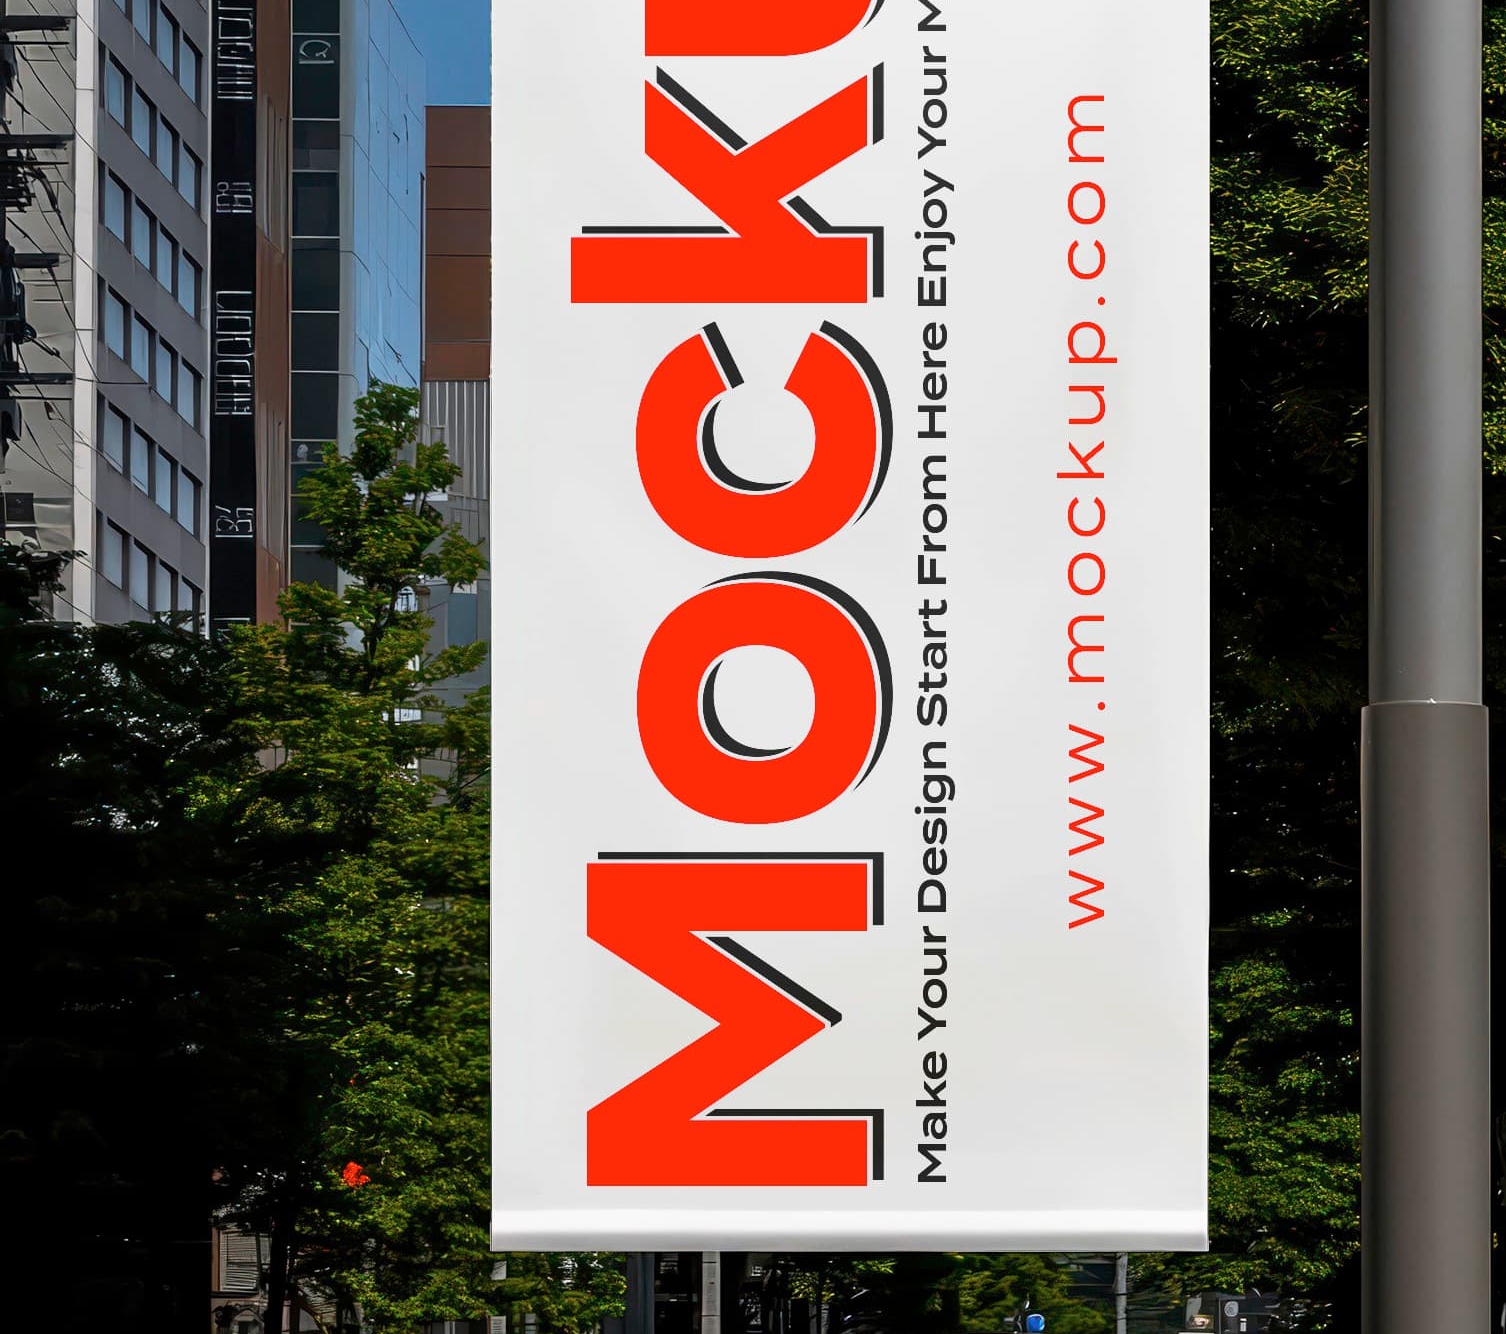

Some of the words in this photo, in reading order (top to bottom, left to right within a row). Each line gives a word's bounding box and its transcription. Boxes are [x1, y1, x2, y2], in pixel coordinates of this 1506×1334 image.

[917, 45, 948, 160] Your
[914, 168, 956, 307] Enjoy
[917, 321, 948, 439] Here
[917, 455, 948, 585] From
[1056, 95, 1118, 930] www.mockup.com
[916, 598, 948, 727] Start
[914, 741, 956, 913] Design
[917, 925, 948, 1042] Your
[915, 1050, 948, 1183] Make
